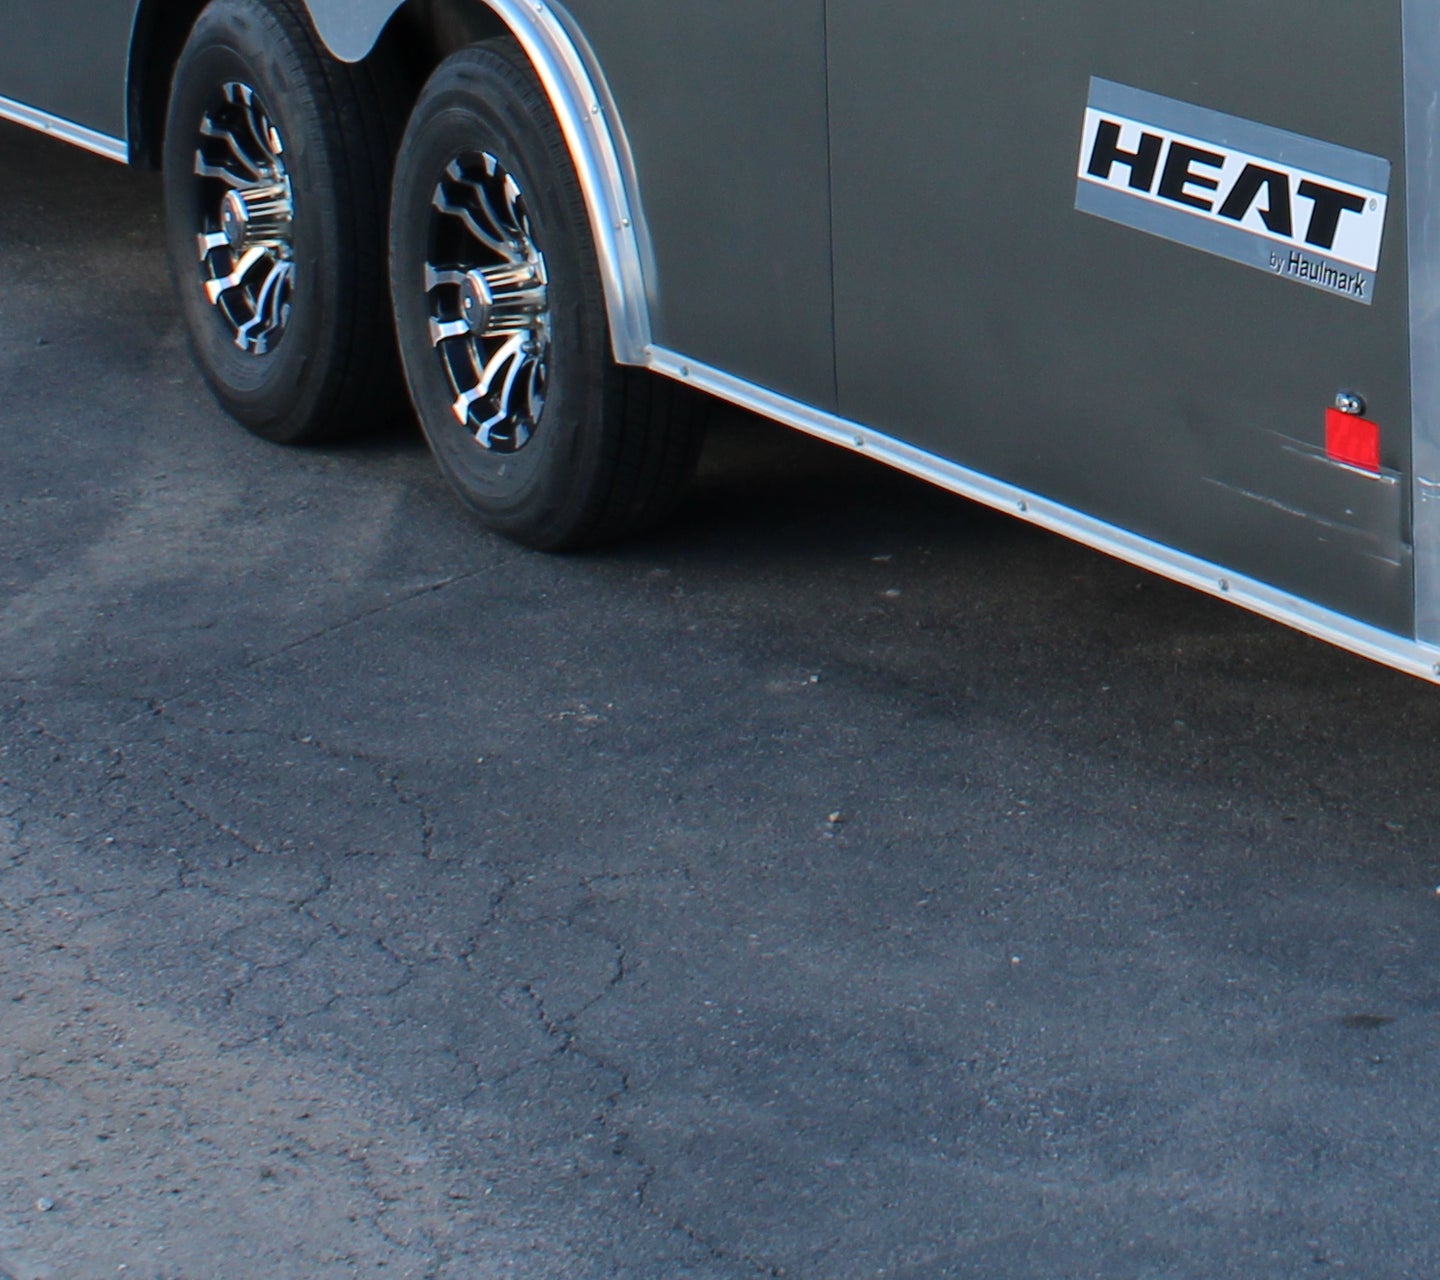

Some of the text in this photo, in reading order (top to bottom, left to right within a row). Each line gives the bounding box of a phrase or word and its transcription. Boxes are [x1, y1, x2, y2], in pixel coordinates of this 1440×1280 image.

[1087, 119, 1366, 250] HEAT
[1269, 250, 1367, 297] by Haulmark
